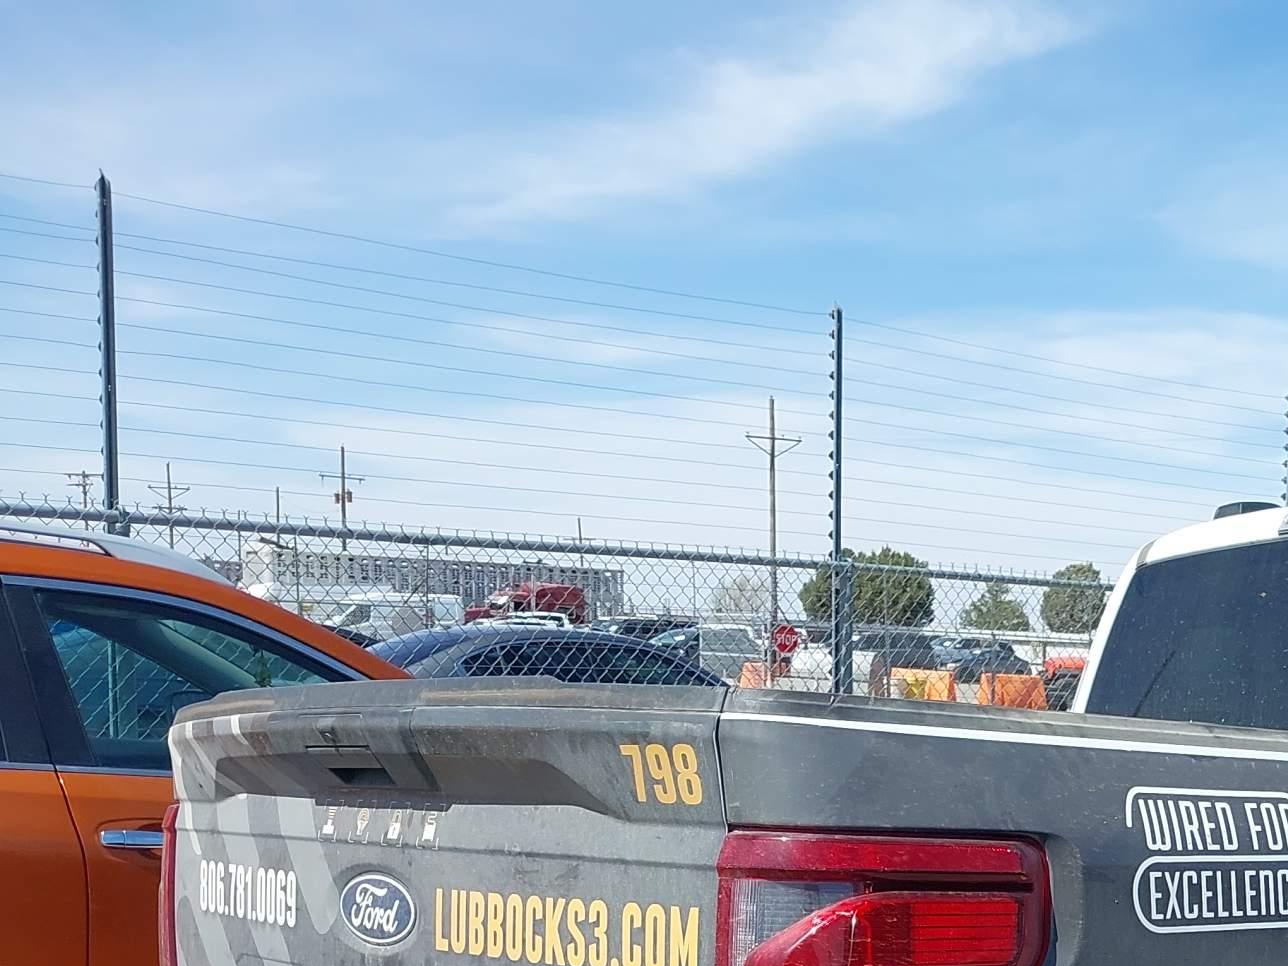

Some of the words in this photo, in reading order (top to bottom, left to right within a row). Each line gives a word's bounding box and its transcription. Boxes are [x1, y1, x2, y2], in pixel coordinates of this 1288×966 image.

[775, 633, 798, 647] STOP
[618, 743, 703, 805] 798
[1137, 798, 1239, 851] WIRED
[199, 859, 297, 928] 806.781.0069
[351, 882, 400, 933] Ford
